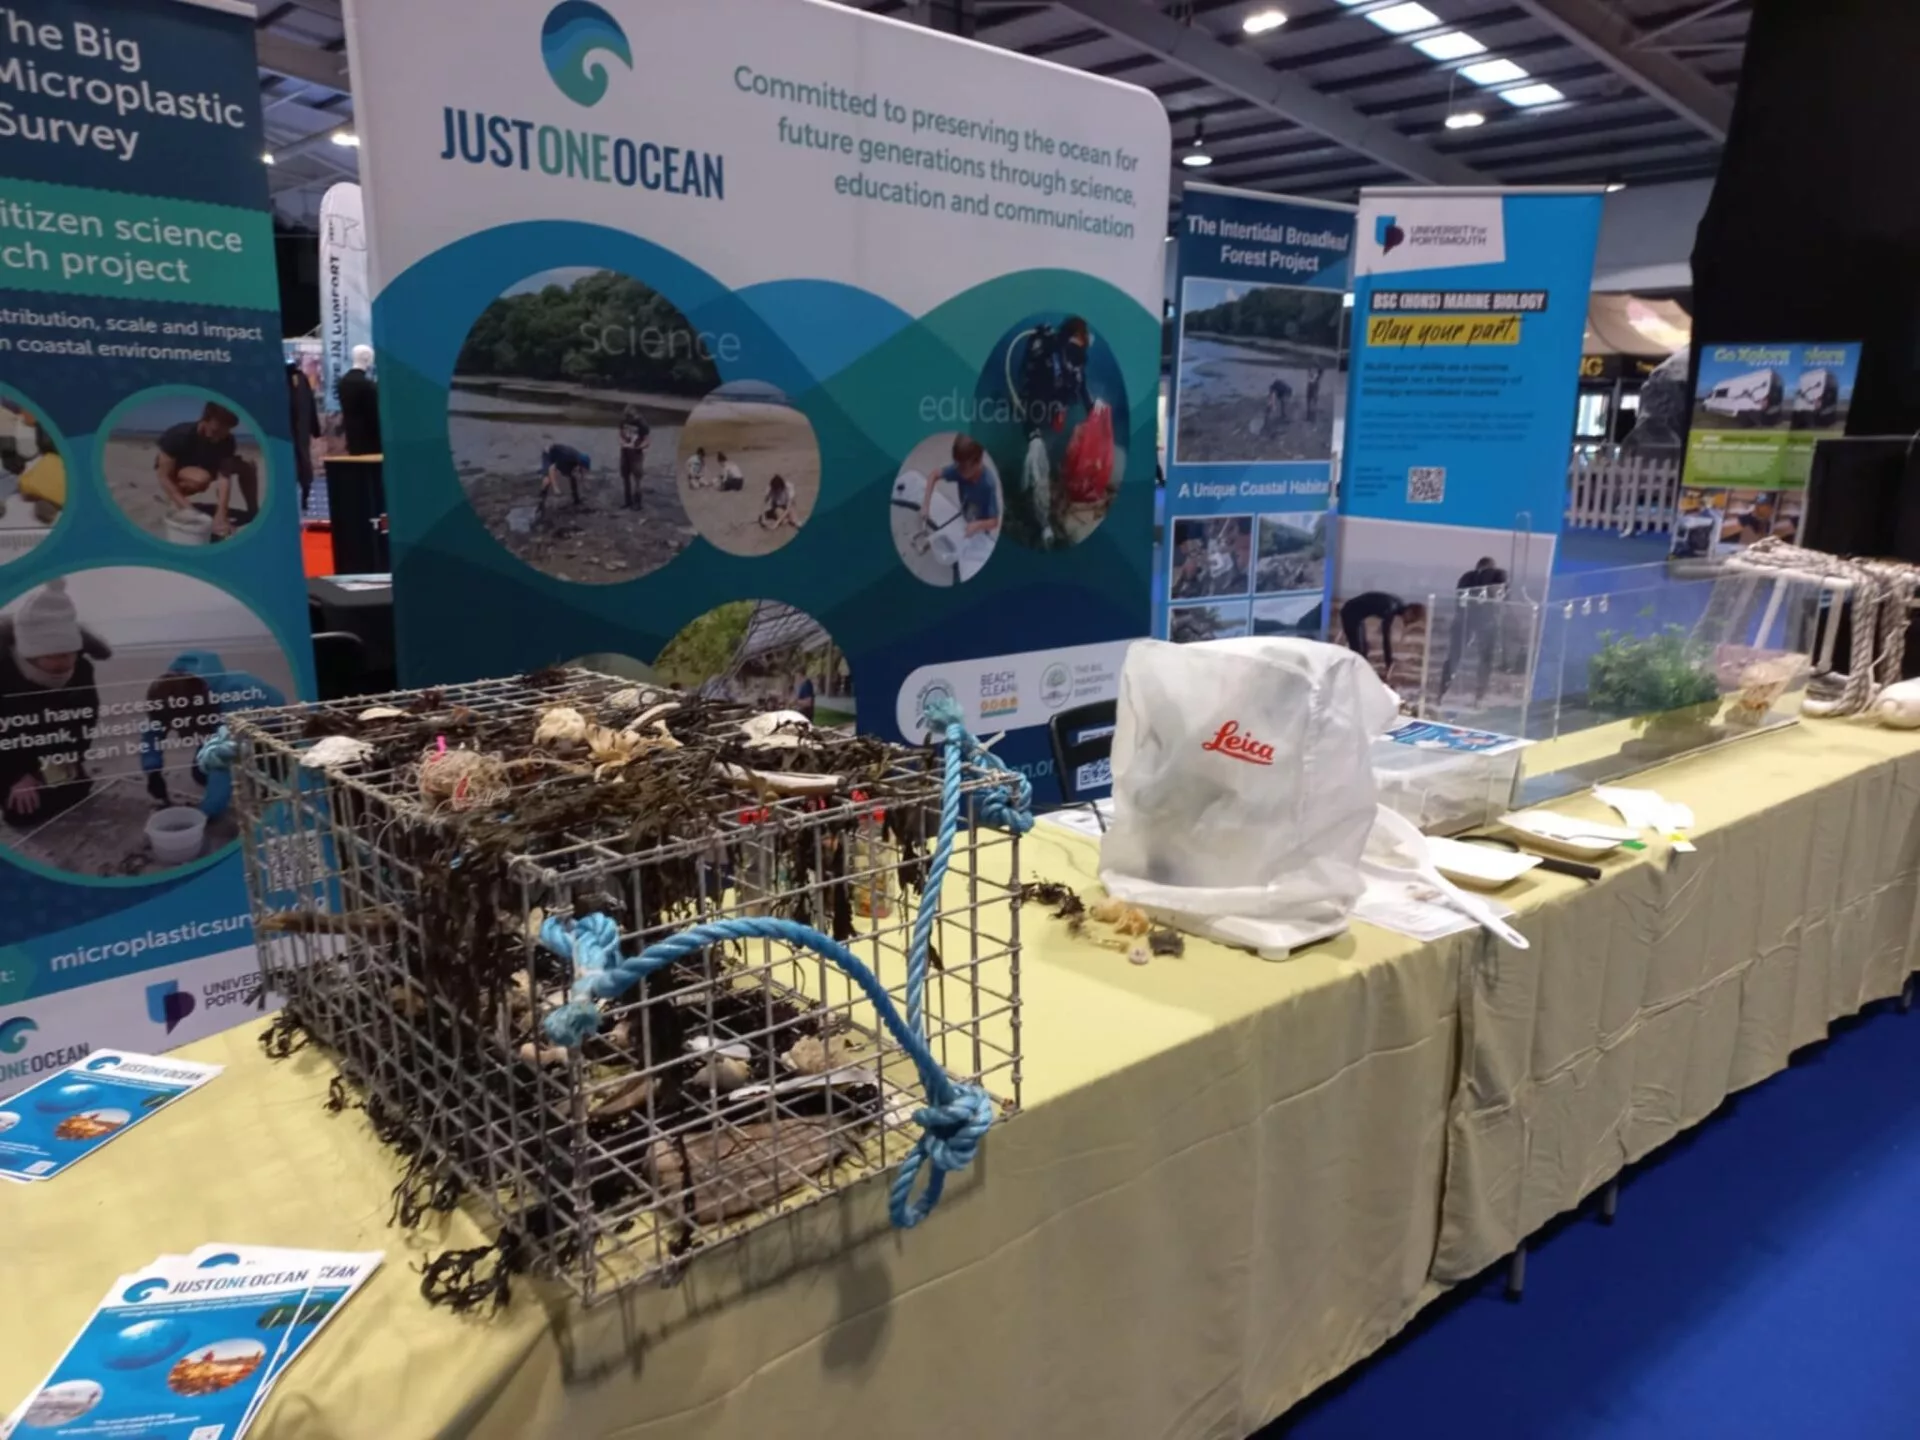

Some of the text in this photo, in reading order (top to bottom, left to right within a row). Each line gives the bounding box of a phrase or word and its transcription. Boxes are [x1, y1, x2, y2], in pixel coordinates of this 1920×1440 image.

[0, 8, 141, 72] he Big
[0, 57, 245, 128] Microplastic
[0, 101, 139, 161] Survey
[734, 65, 1139, 173] Committed to preserving the ocean for
[440, 106, 724, 200] JUSTONEOCEAN
[777, 116, 1137, 208] future generations through science,
[834, 172, 1135, 239] education and communication
[114, 217, 243, 252] science
[1186, 214, 1349, 250] The Intertidal Broadleaf
[1409, 234, 1486, 247] PORTSMOUTH
[1410, 225, 1475, 235] UNIVERSITY
[0, 242, 190, 285] ch project
[1220, 245, 1319, 274] Forest Project
[1443, 292, 1491, 310] MARINE
[1493, 291, 1546, 310] BIOLOGY
[105, 316, 158, 334] scale
[162, 320, 198, 336] and
[203, 321, 263, 342] impact
[579, 315, 741, 362] science
[1371, 318, 1413, 349] Play
[1417, 323, 1465, 349] your
[16, 338, 92, 356] coastal
[97, 342, 231, 362] environments
[919, 386, 1068, 424] education
[1178, 483, 1190, 499] A
[1193, 481, 1237, 499] Unique
[1240, 480, 1286, 496] Coastal
[980, 671, 1015, 687] BEACH
[0, 710, 39, 733] you
[44, 706, 93, 724] have
[99, 699, 164, 717] access
[168, 693, 189, 709] to
[193, 694, 205, 706] a
[171, 713, 192, 729] or
[38, 753, 79, 771] you
[84, 746, 120, 760] can
[126, 739, 150, 755] be
[1202, 720, 1274, 765] Leica
[169, 1269, 309, 1295] JUSTONEOCEAN
